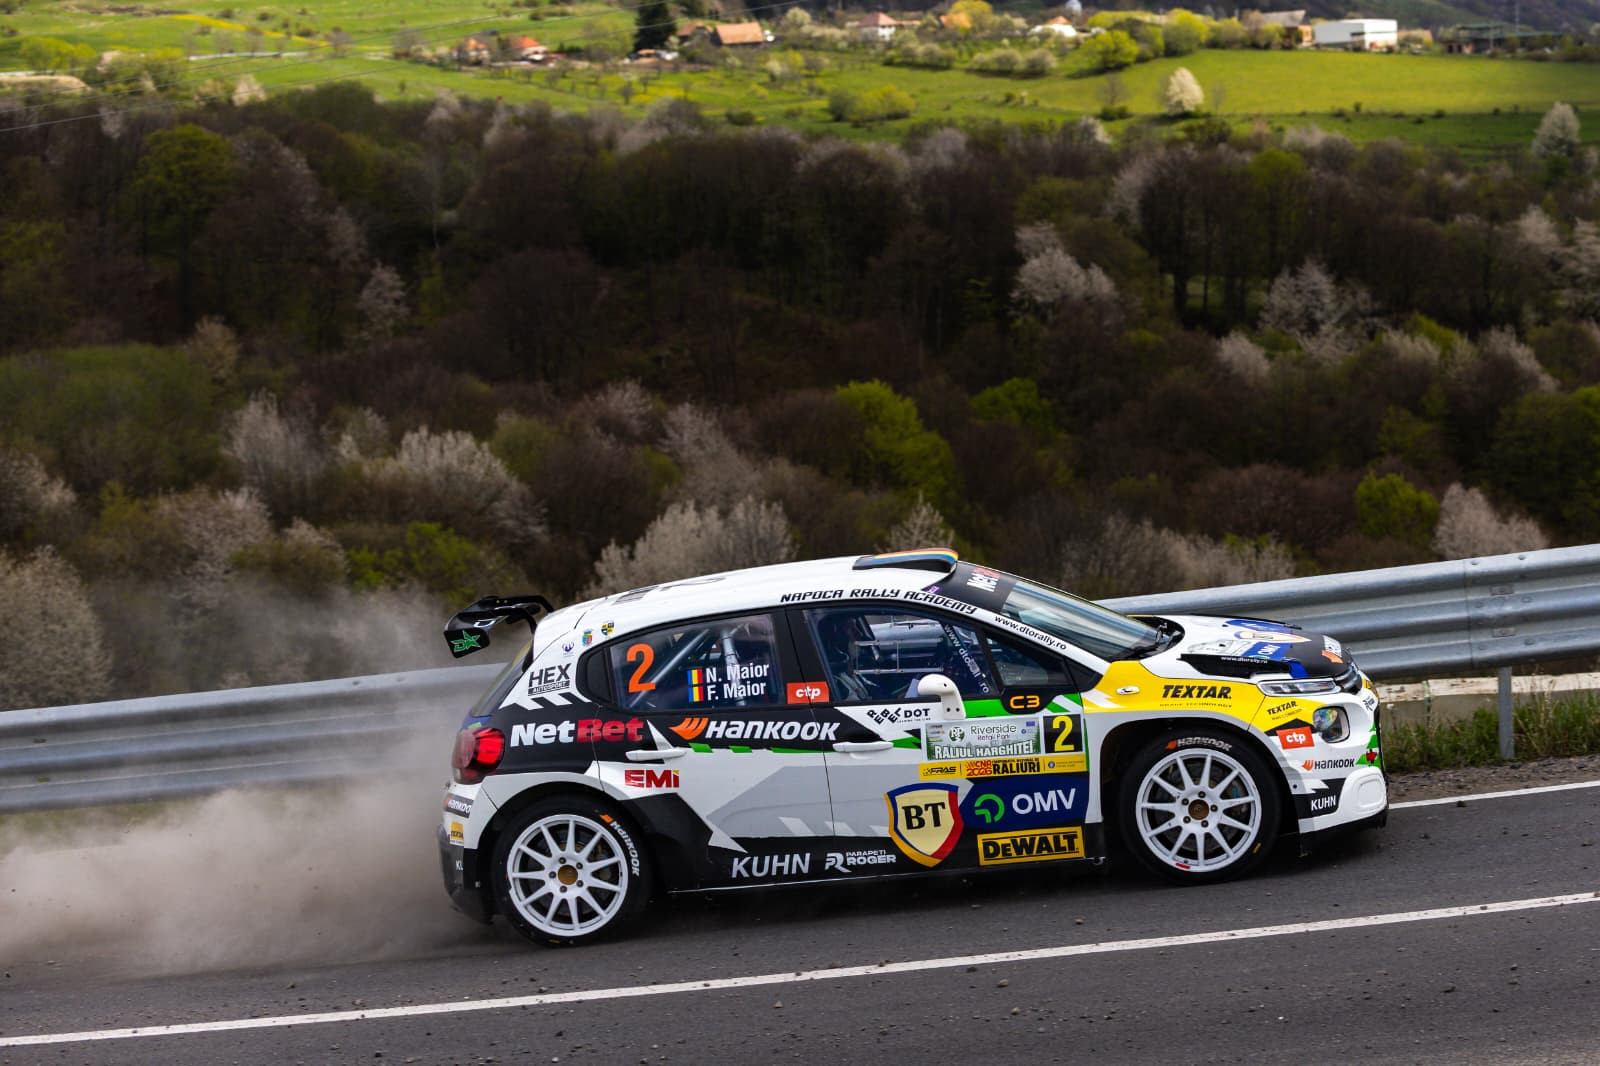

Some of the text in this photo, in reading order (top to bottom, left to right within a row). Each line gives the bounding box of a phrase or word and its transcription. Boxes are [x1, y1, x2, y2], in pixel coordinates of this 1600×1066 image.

[780, 588, 978, 615] NAPOCA RALLY ACADEMY
[994, 615, 1067, 650] www.dtorally.ro
[528, 663, 572, 688] HEX
[625, 642, 656, 694] 2
[706, 662, 770, 684] N. Maior
[707, 682, 767, 701] F. Maior
[795, 686, 821, 699] ctp
[1162, 684, 1232, 699] TEXTAR
[1009, 695, 1041, 709] C3
[904, 708, 930, 719] DOT
[510, 717, 644, 747] NetBet
[970, 723, 1017, 735] Riverside
[1052, 715, 1075, 752] 2
[1286, 730, 1306, 745] ctp
[934, 744, 974, 760] RALIUL
[975, 739, 1034, 757] HARGHITEI
[992, 761, 1041, 776] RALIURI
[1012, 788, 1077, 815] OMV
[1311, 795, 1336, 811] KUHN
[902, 802, 946, 830] BT
[846, 849, 887, 857] PARAPETI
[846, 854, 897, 866] ROGER
[731, 852, 811, 878] KUHN
